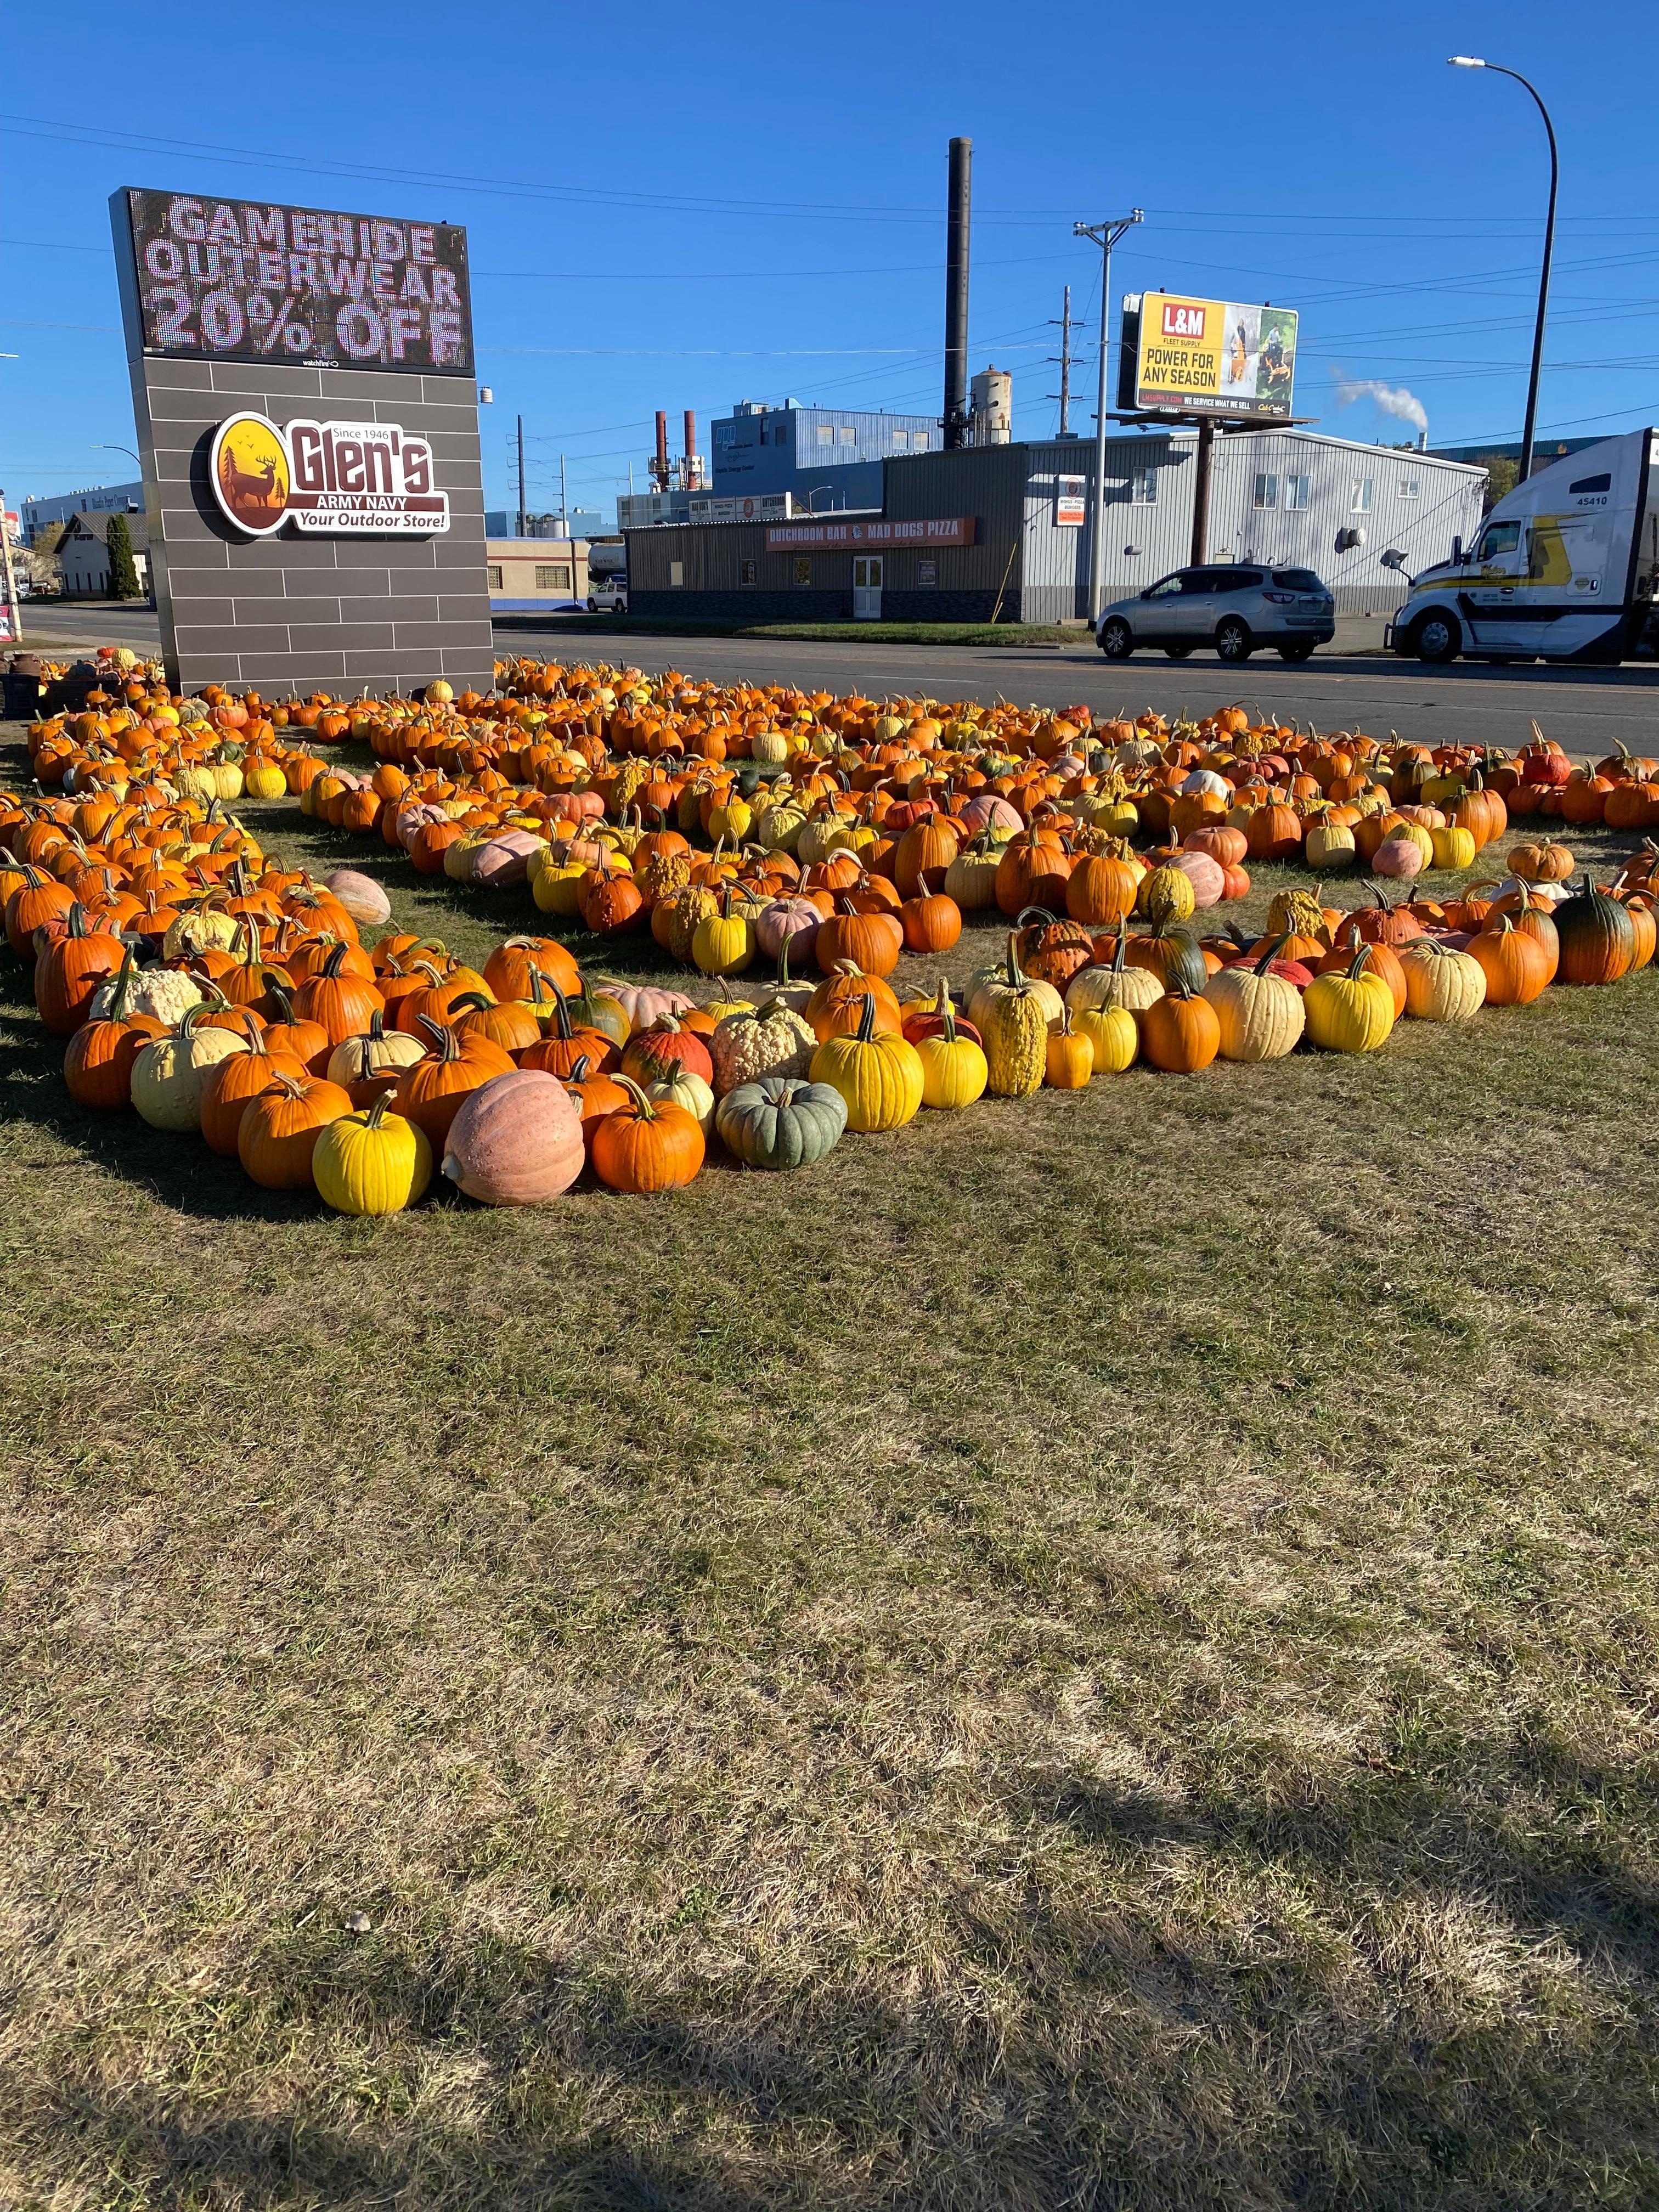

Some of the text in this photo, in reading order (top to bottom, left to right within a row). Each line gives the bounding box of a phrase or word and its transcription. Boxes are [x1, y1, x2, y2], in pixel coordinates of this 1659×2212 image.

[170, 195, 437, 262] GAMEHIDE
[145, 239, 461, 308] OUTERWEAR
[142, 284, 464, 366] 20% OFF
[1164, 307, 1204, 336] L&M
[1147, 348, 1214, 369] POWER FOR
[1143, 366, 1216, 387] ANY SEASON
[1184, 397, 1250, 410] WE SERVICE WHAT WE SELL
[333, 428, 388, 439] Since 1946
[291, 426, 430, 494] Glen's
[317, 495, 407, 510] ARMY NAVY
[1577, 496, 1607, 505] 45410
[301, 512, 445, 528] Your Outdoor Store!
[770, 521, 958, 542] DUTCHROOM BAR MAD DOGS PIZZA
